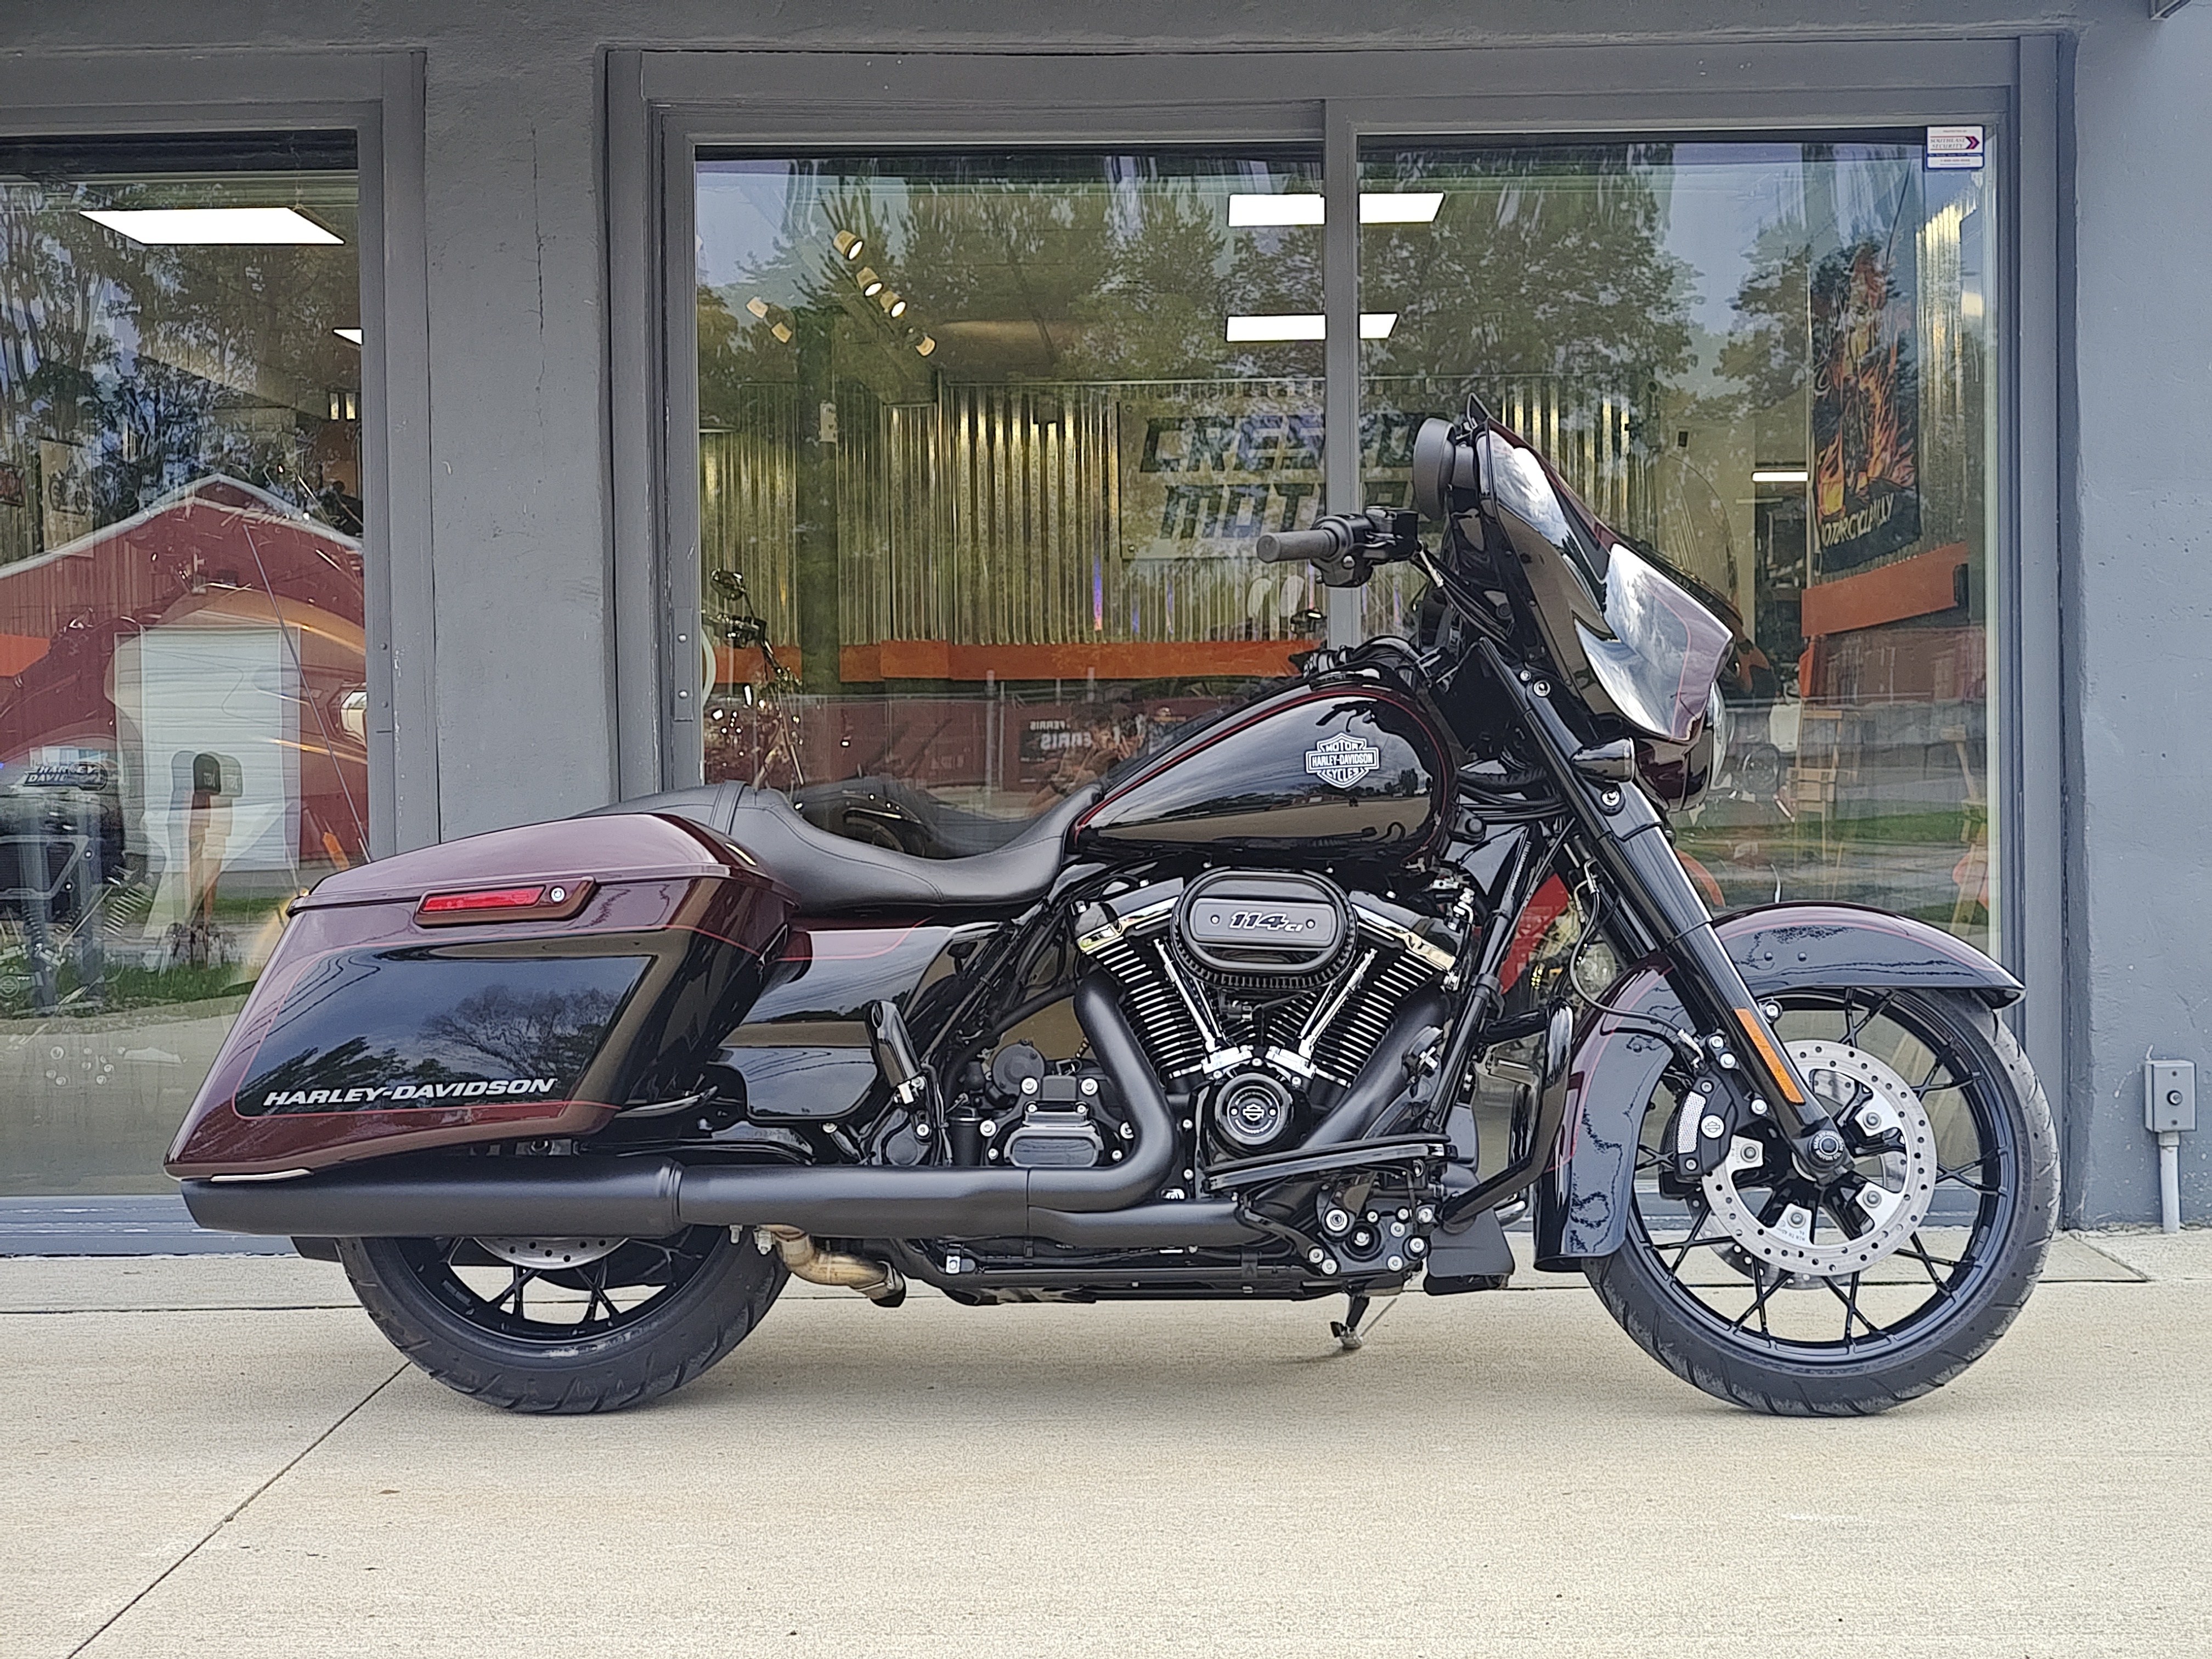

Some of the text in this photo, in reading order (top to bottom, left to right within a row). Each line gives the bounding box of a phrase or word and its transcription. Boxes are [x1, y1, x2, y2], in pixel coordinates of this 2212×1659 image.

[1325, 740, 1359, 752] MOTOR
[1312, 753, 1373, 767] HARLEY-DAVIDSON
[1326, 768, 1359, 782] CYCLES
[263, 1078, 557, 1106] HARLEY-DAVIDSON
